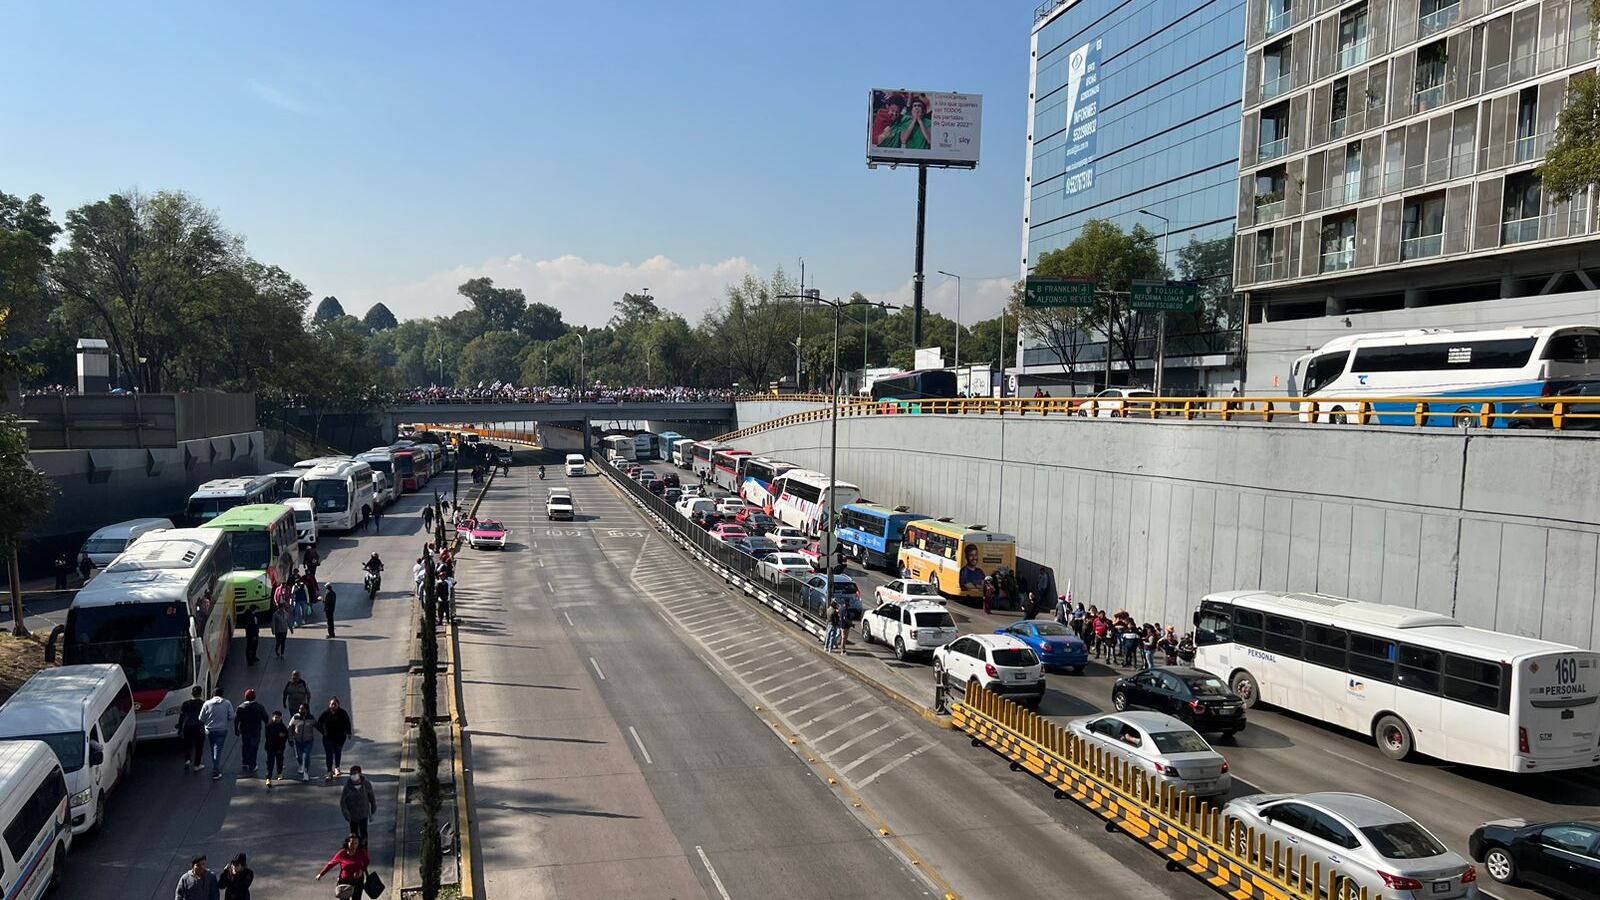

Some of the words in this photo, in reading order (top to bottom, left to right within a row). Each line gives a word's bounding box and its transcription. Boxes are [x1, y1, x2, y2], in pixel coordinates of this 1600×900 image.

[1073, 102, 1096, 124] INFORMES
[1045, 285, 1078, 293] FRANKLIN
[1155, 287, 1185, 295] TOLUCA
[1036, 295, 1068, 303] ALFONSO
[1070, 295, 1093, 304] REYES
[1134, 293, 1162, 301] REFORMA
[1164, 294, 1184, 302] LOMAS
[1132, 301, 1155, 309] MARIANO
[1247, 648, 1277, 663] PERSONAL
[1555, 657, 1577, 684] 160
[1545, 684, 1587, 696] PERSONAL
